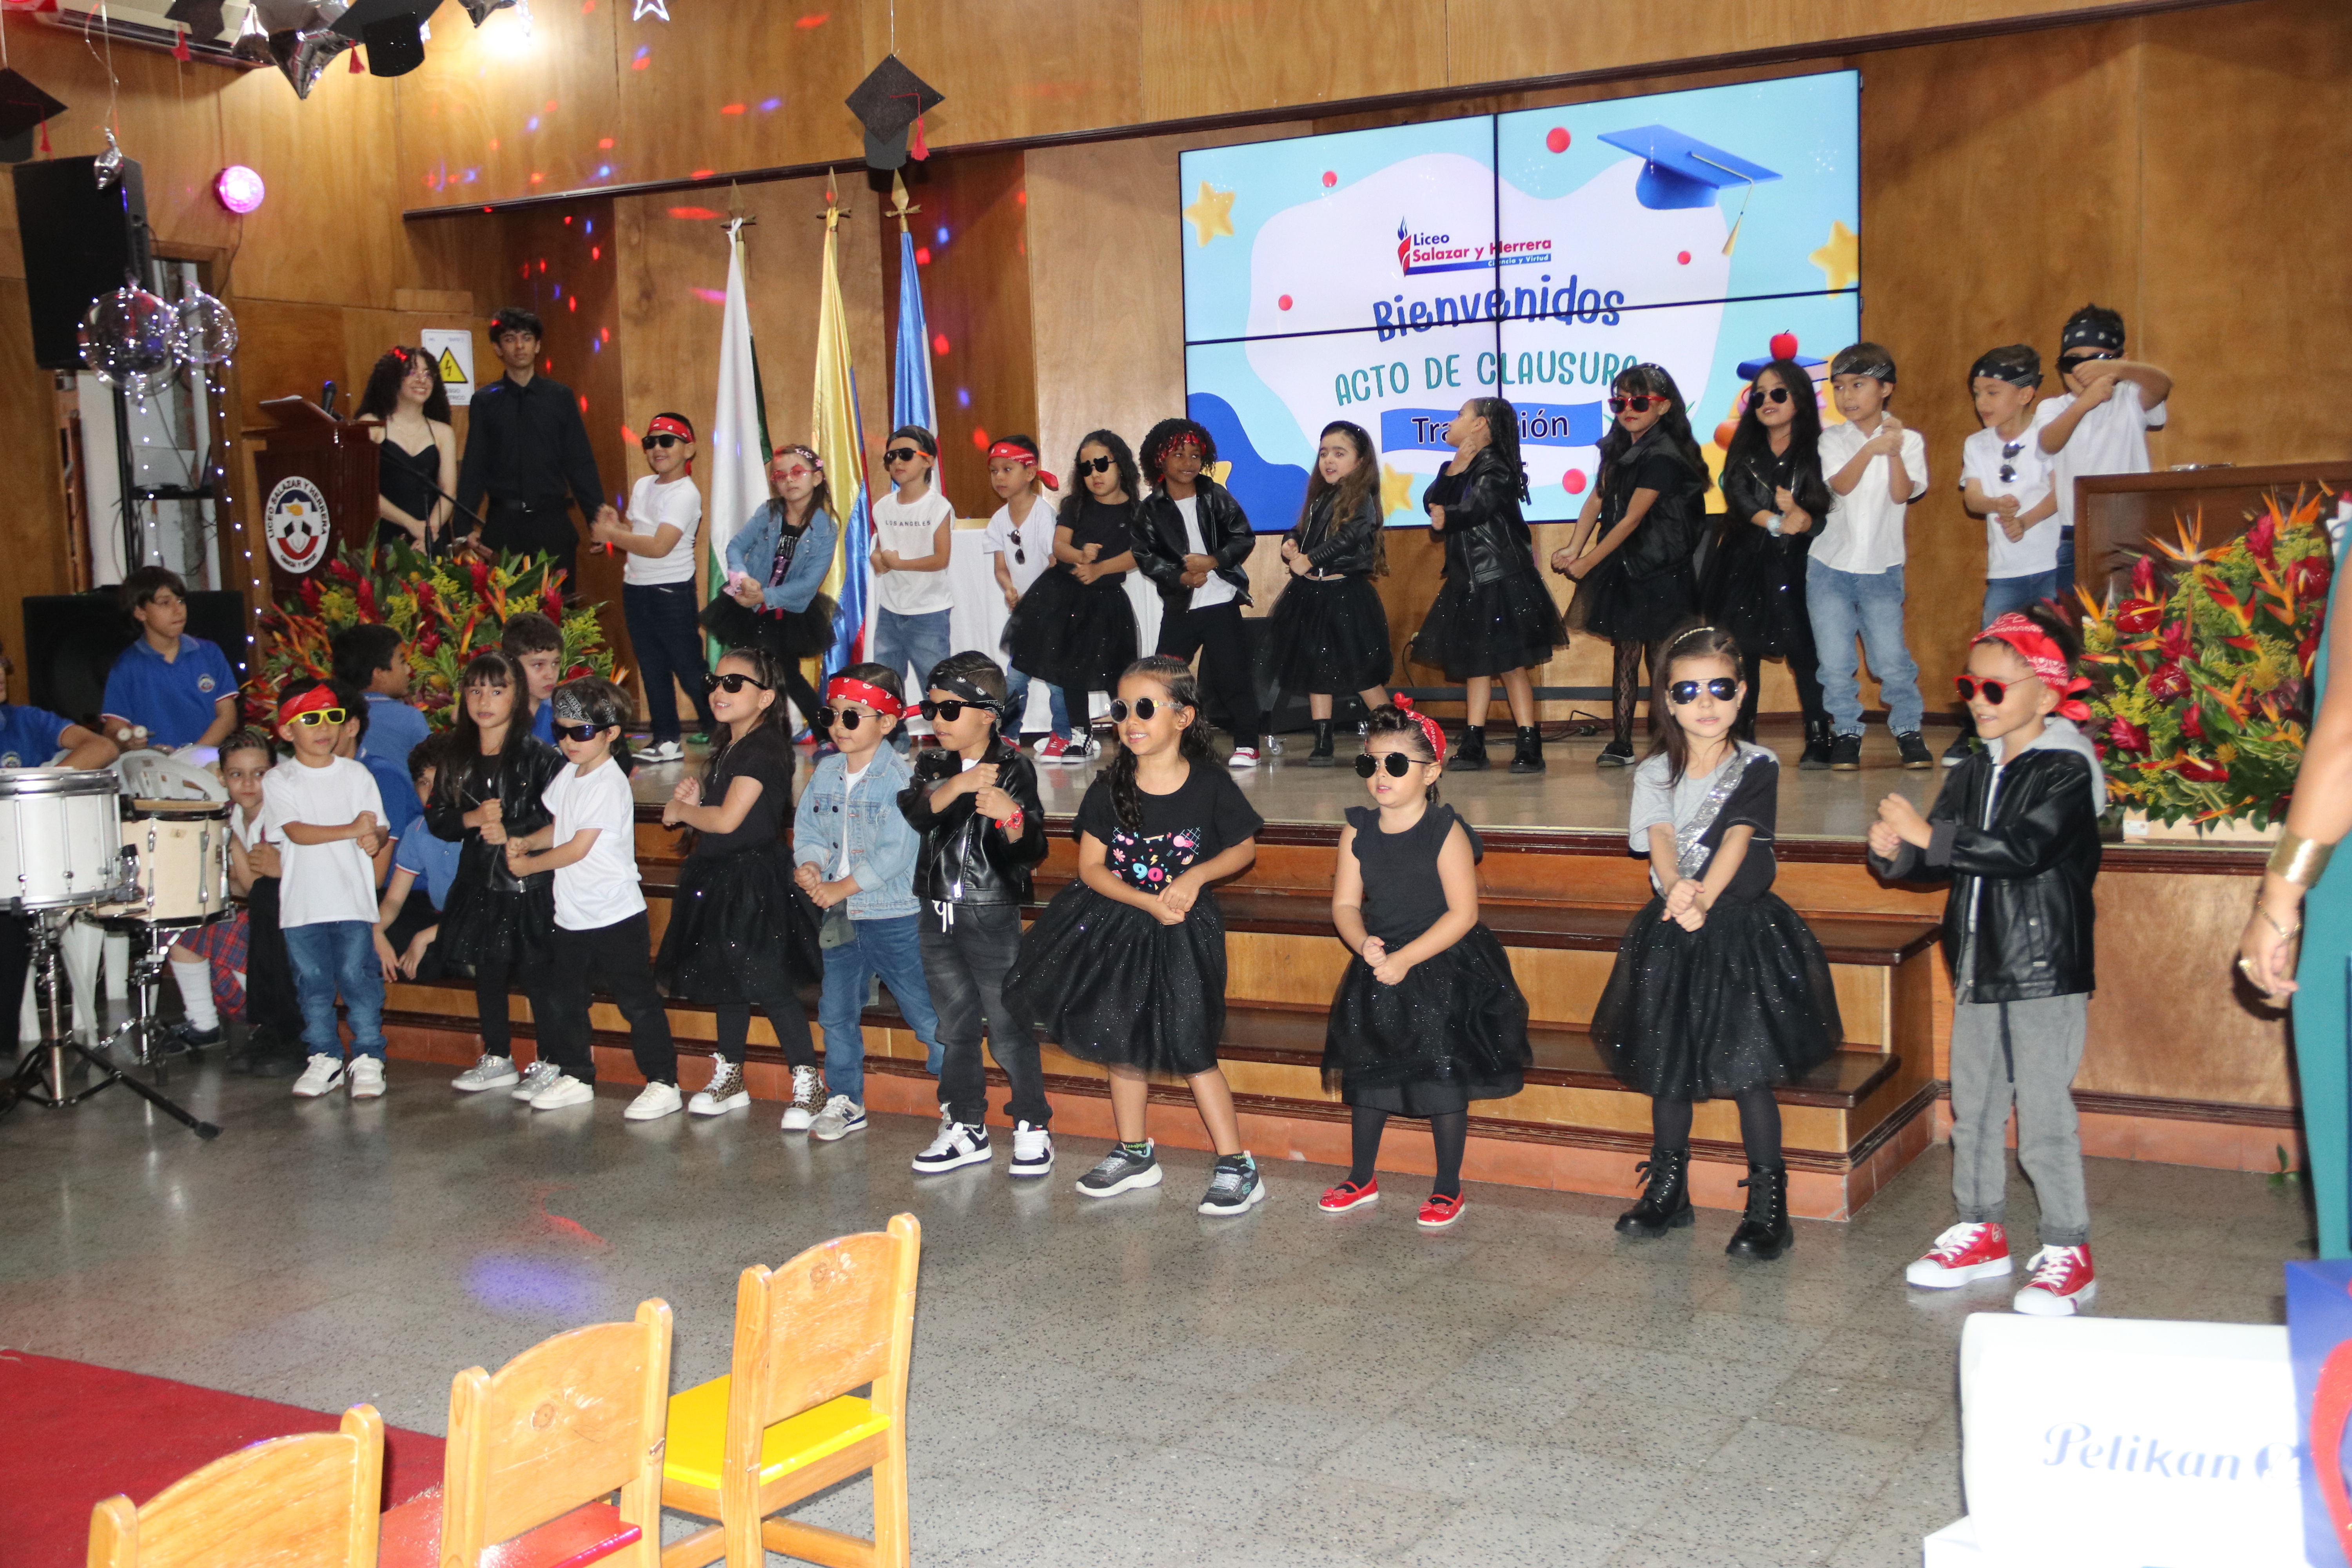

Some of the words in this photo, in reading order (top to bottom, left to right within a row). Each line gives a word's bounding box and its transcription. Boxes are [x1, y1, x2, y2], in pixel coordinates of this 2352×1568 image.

[1413, 247, 1470, 263] Salazar
[1475, 247, 1484, 261] y
[1490, 239, 1552, 256] Herrera
[1414, 232, 1450, 246] Liceo
[1488, 257, 1516, 267] Cincia
[1525, 254, 1549, 263] Virtud
[1373, 274, 1625, 343] Bienvenidos
[1335, 361, 1409, 406] ACTO
[1425, 354, 1462, 389] DE
[272, 479, 301, 505] SALAZAR
[310, 487, 328, 535] HERRERA
[2043, 1421, 2241, 1481] Pelikan
